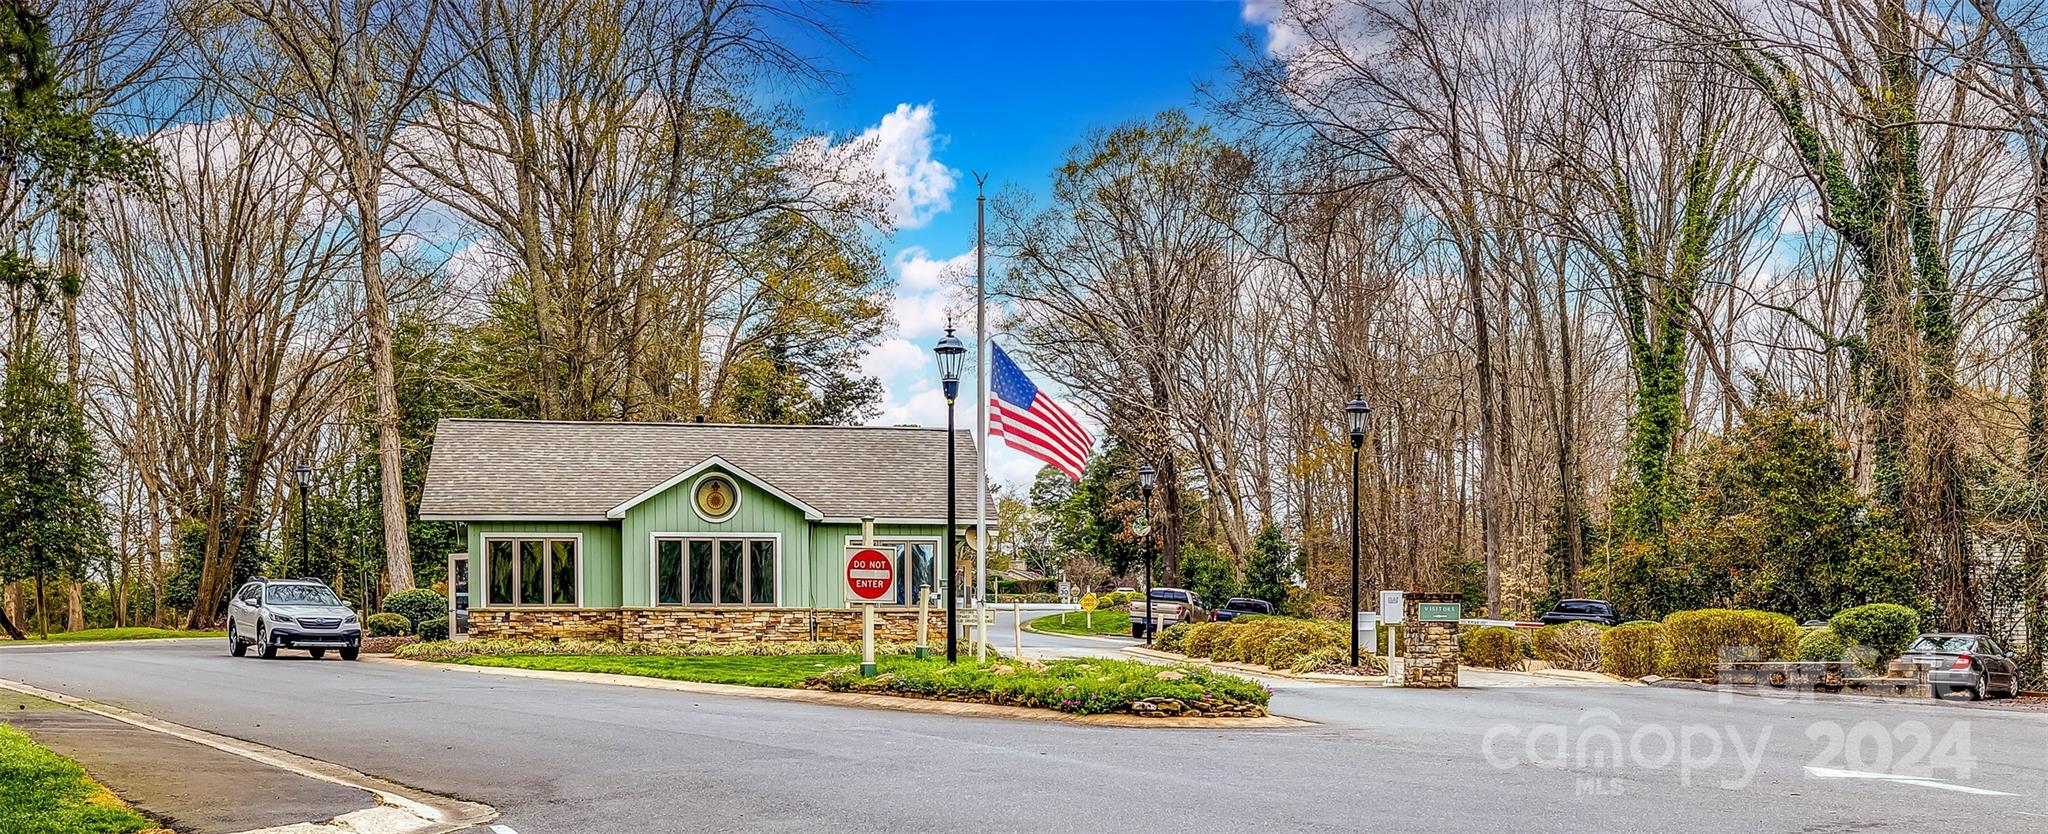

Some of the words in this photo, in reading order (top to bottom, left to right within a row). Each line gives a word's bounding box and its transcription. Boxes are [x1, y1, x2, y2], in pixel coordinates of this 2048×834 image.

[853, 560, 866, 568] DO
[869, 560, 886, 569] NOT
[856, 579, 884, 588] ENTER
